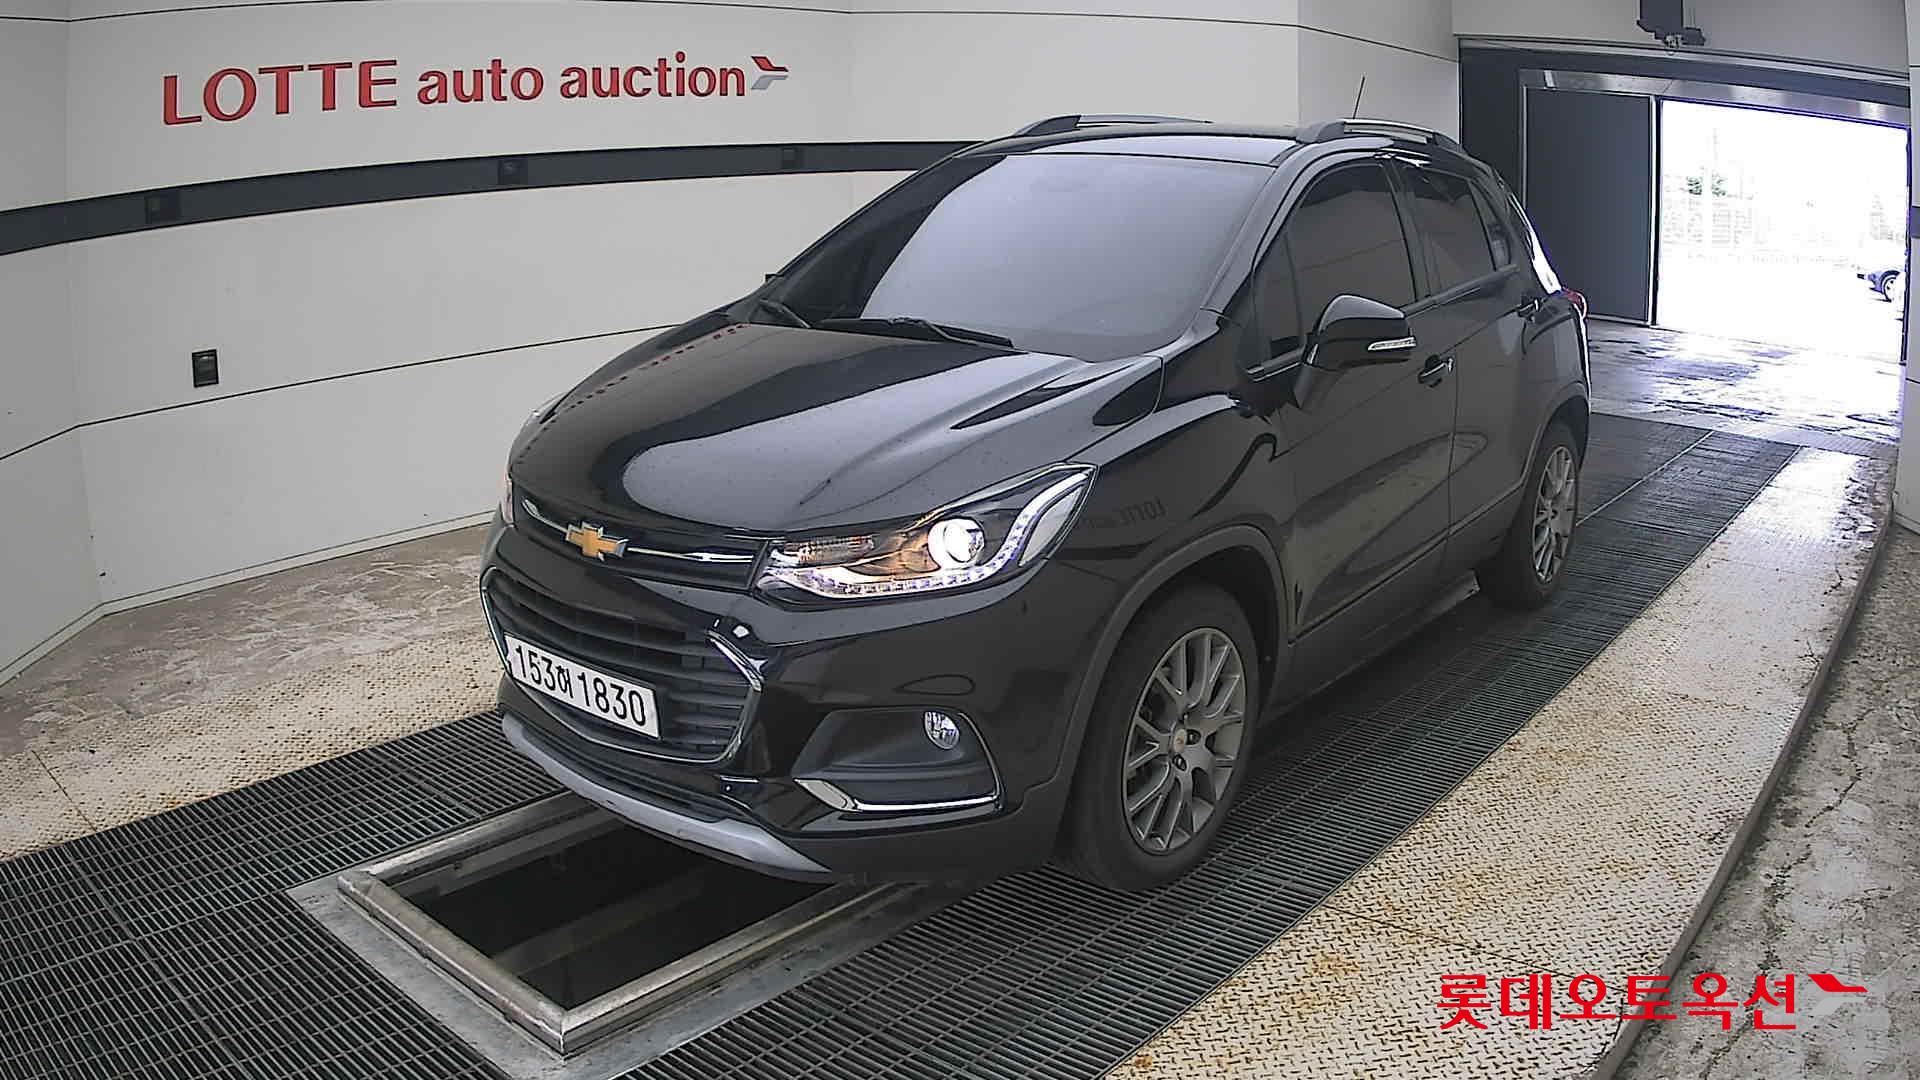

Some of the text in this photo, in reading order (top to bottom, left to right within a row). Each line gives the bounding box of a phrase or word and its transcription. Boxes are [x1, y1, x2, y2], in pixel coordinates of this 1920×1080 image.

[163, 51, 746, 126] LOTTE auto auction
